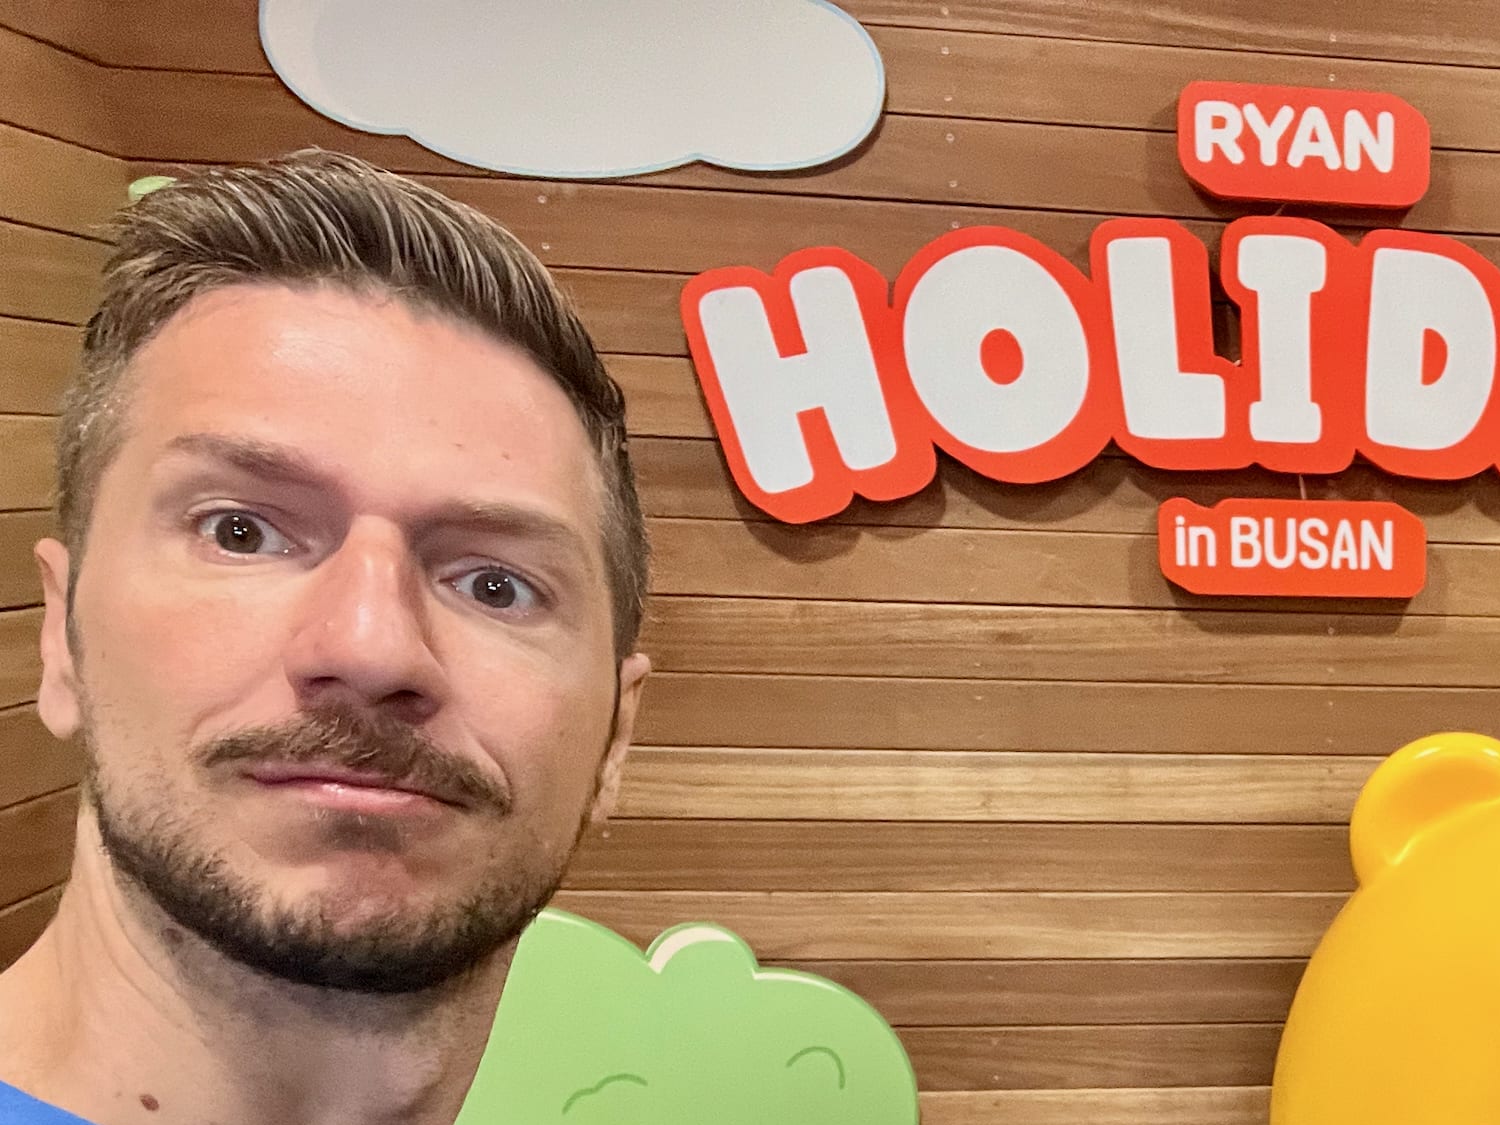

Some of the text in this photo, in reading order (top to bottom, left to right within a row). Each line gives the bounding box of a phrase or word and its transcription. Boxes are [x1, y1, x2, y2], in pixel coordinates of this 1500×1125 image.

[1193, 99, 1395, 174] RYAN
[1174, 515, 1394, 571] in BUSAN
